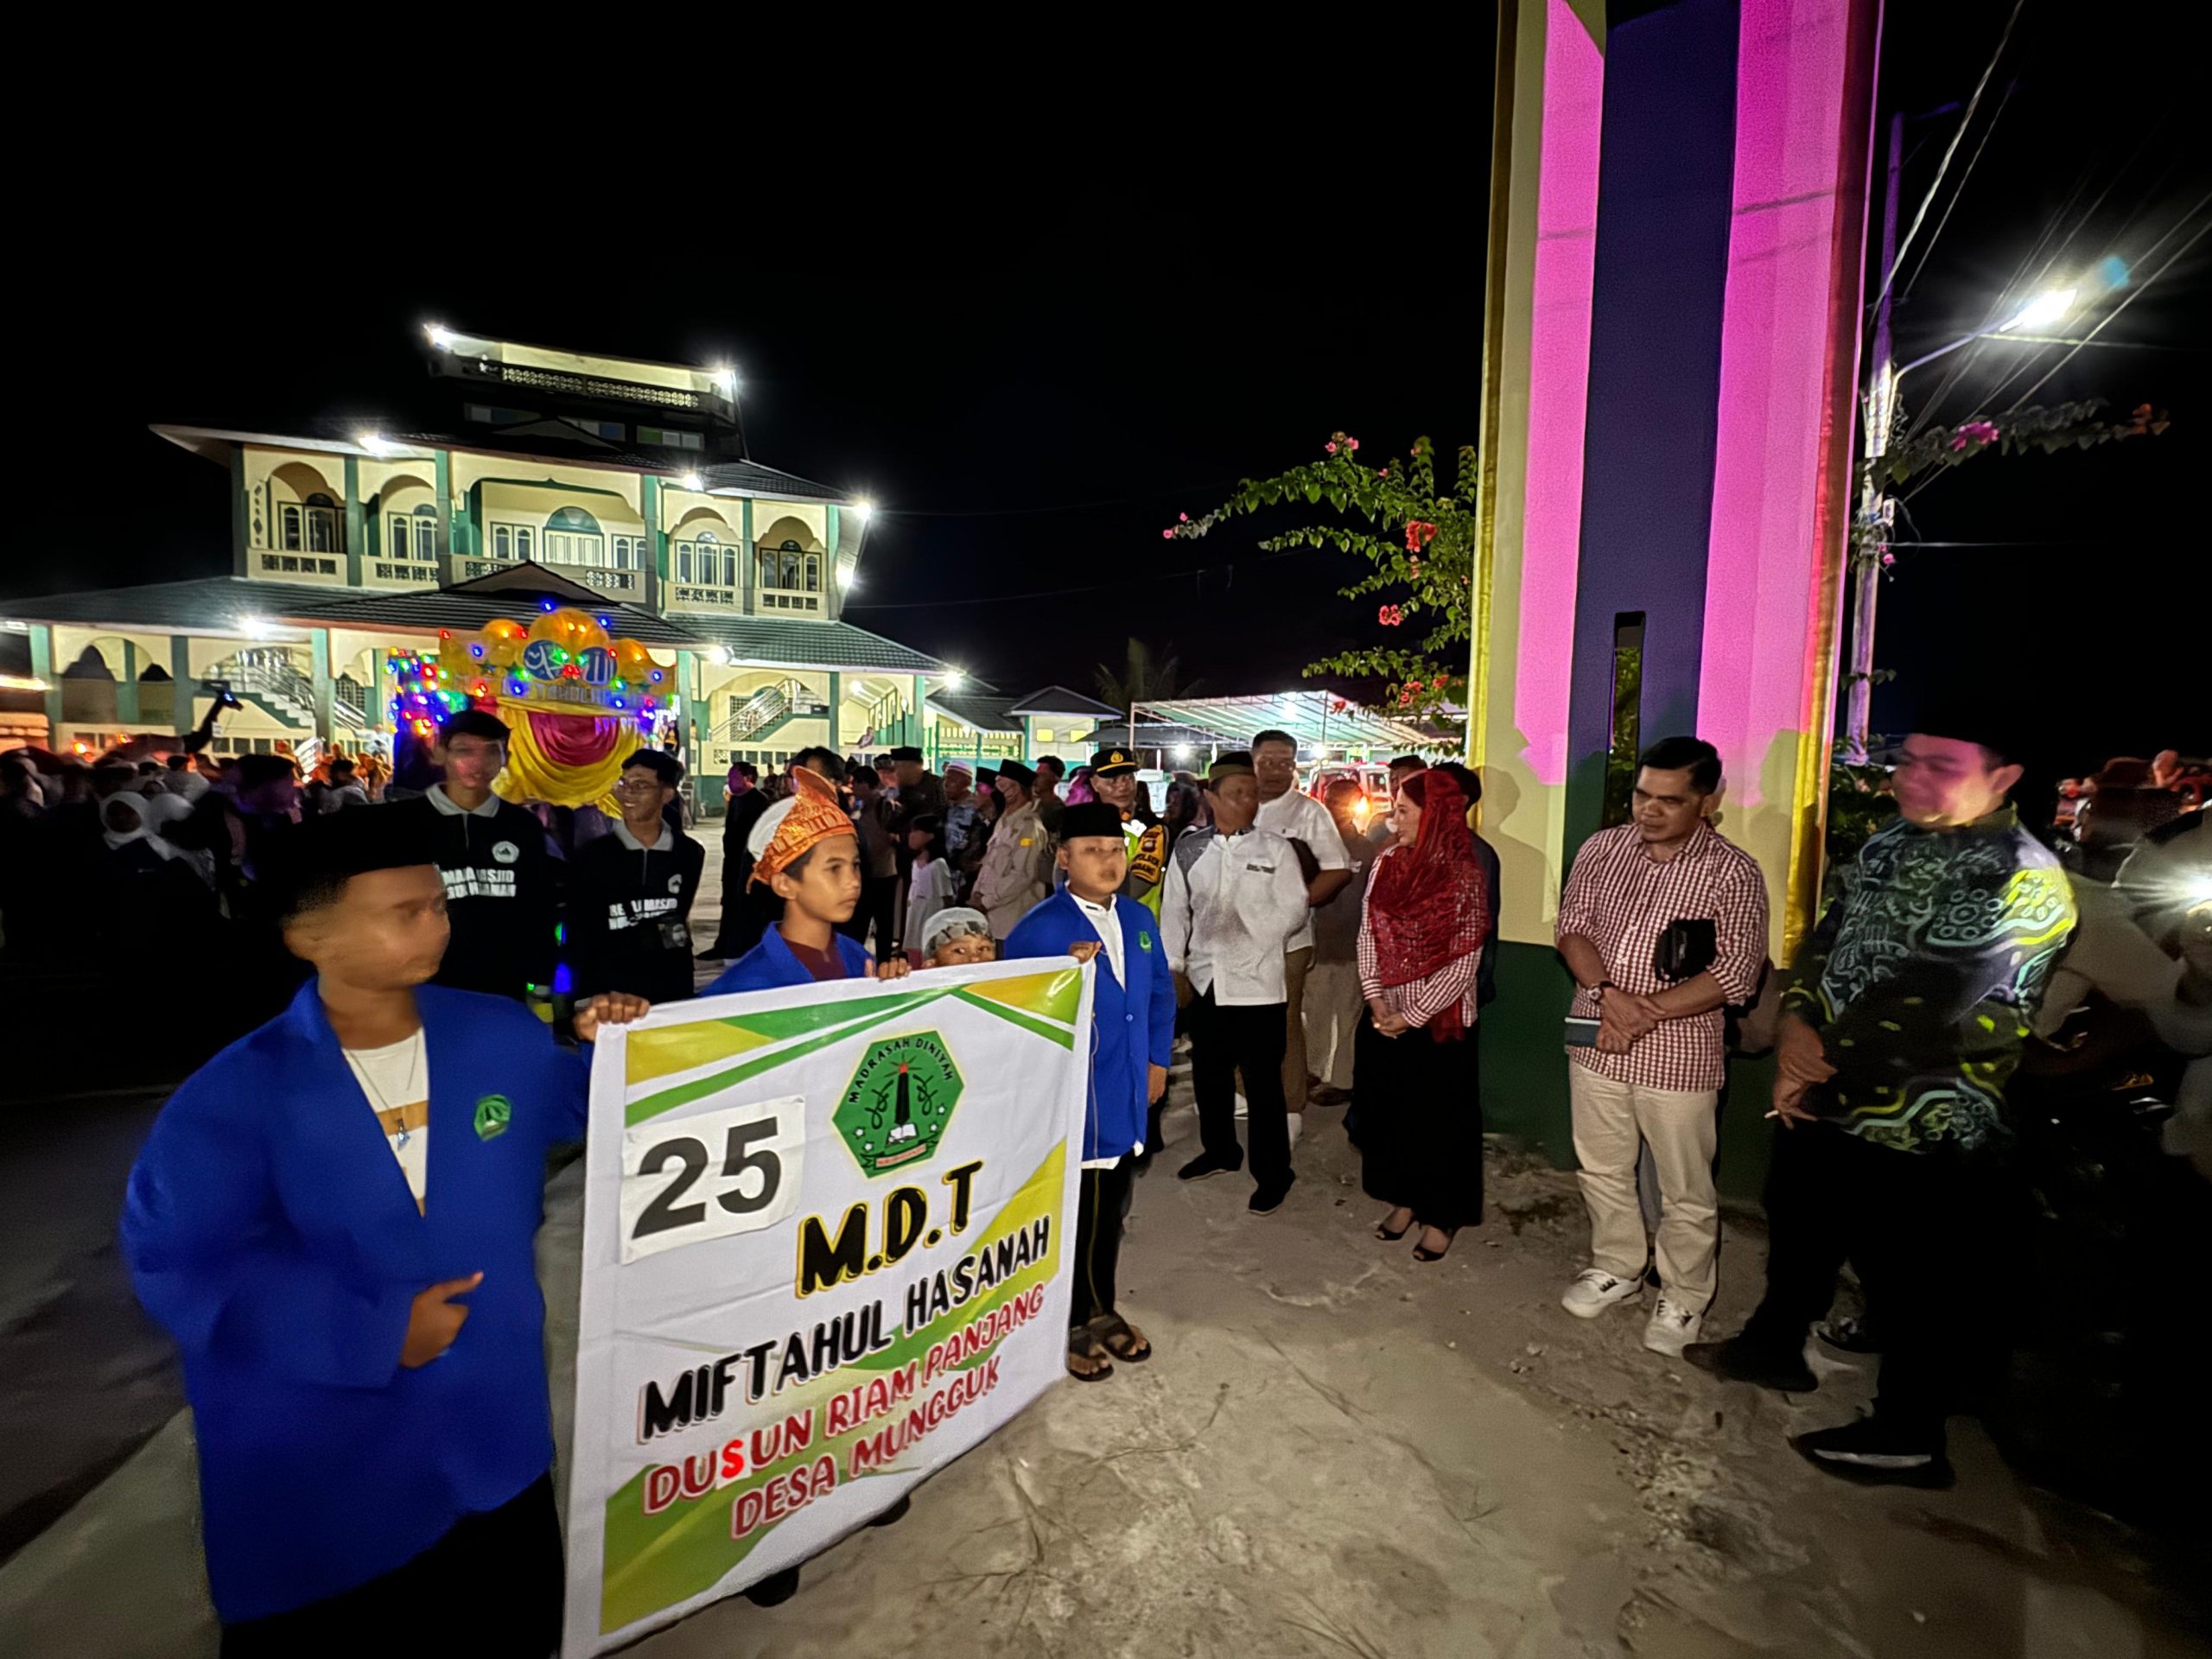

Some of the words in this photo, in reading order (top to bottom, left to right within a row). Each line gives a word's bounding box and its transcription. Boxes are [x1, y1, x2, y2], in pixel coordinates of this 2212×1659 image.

[849, 1038, 910, 1103] MADRASAH
[916, 1038, 953, 1080] DINIYAH
[632, 1116, 781, 1240] 25
[795, 1160, 983, 1299] M.D.T
[639, 1300, 892, 1443] MIFTAHUL
[904, 1214, 1050, 1336] HASANAH
[645, 1409, 813, 1514] DUSUN
[824, 1361, 916, 1438] RIAM
[923, 1282, 1045, 1388] PANJANG
[732, 1452, 836, 1539] DESA
[847, 1356, 1001, 1479] MUNGGUK
